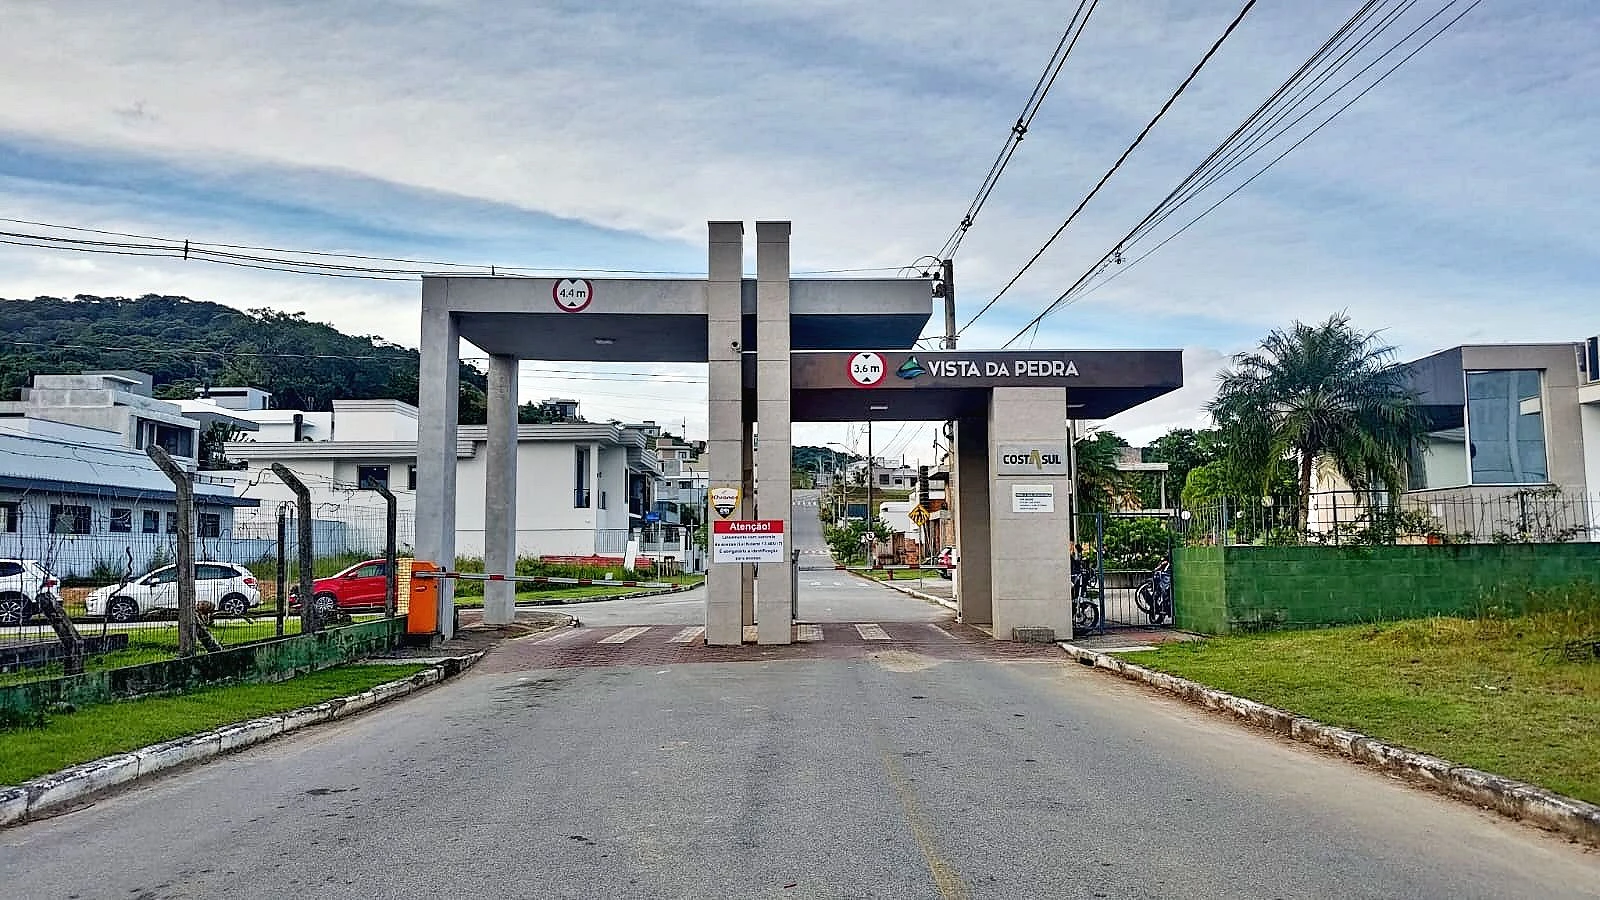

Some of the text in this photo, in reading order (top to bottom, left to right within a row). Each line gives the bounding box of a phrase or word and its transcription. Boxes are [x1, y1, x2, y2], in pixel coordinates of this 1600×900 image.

[559, 288, 586, 298] 4.4 m
[853, 364, 880, 373] 3.6 m
[928, 360, 1080, 377] VISTA DA PEDRA
[1041, 454, 1062, 465] SUL
[729, 522, 771, 532] Atenção!
